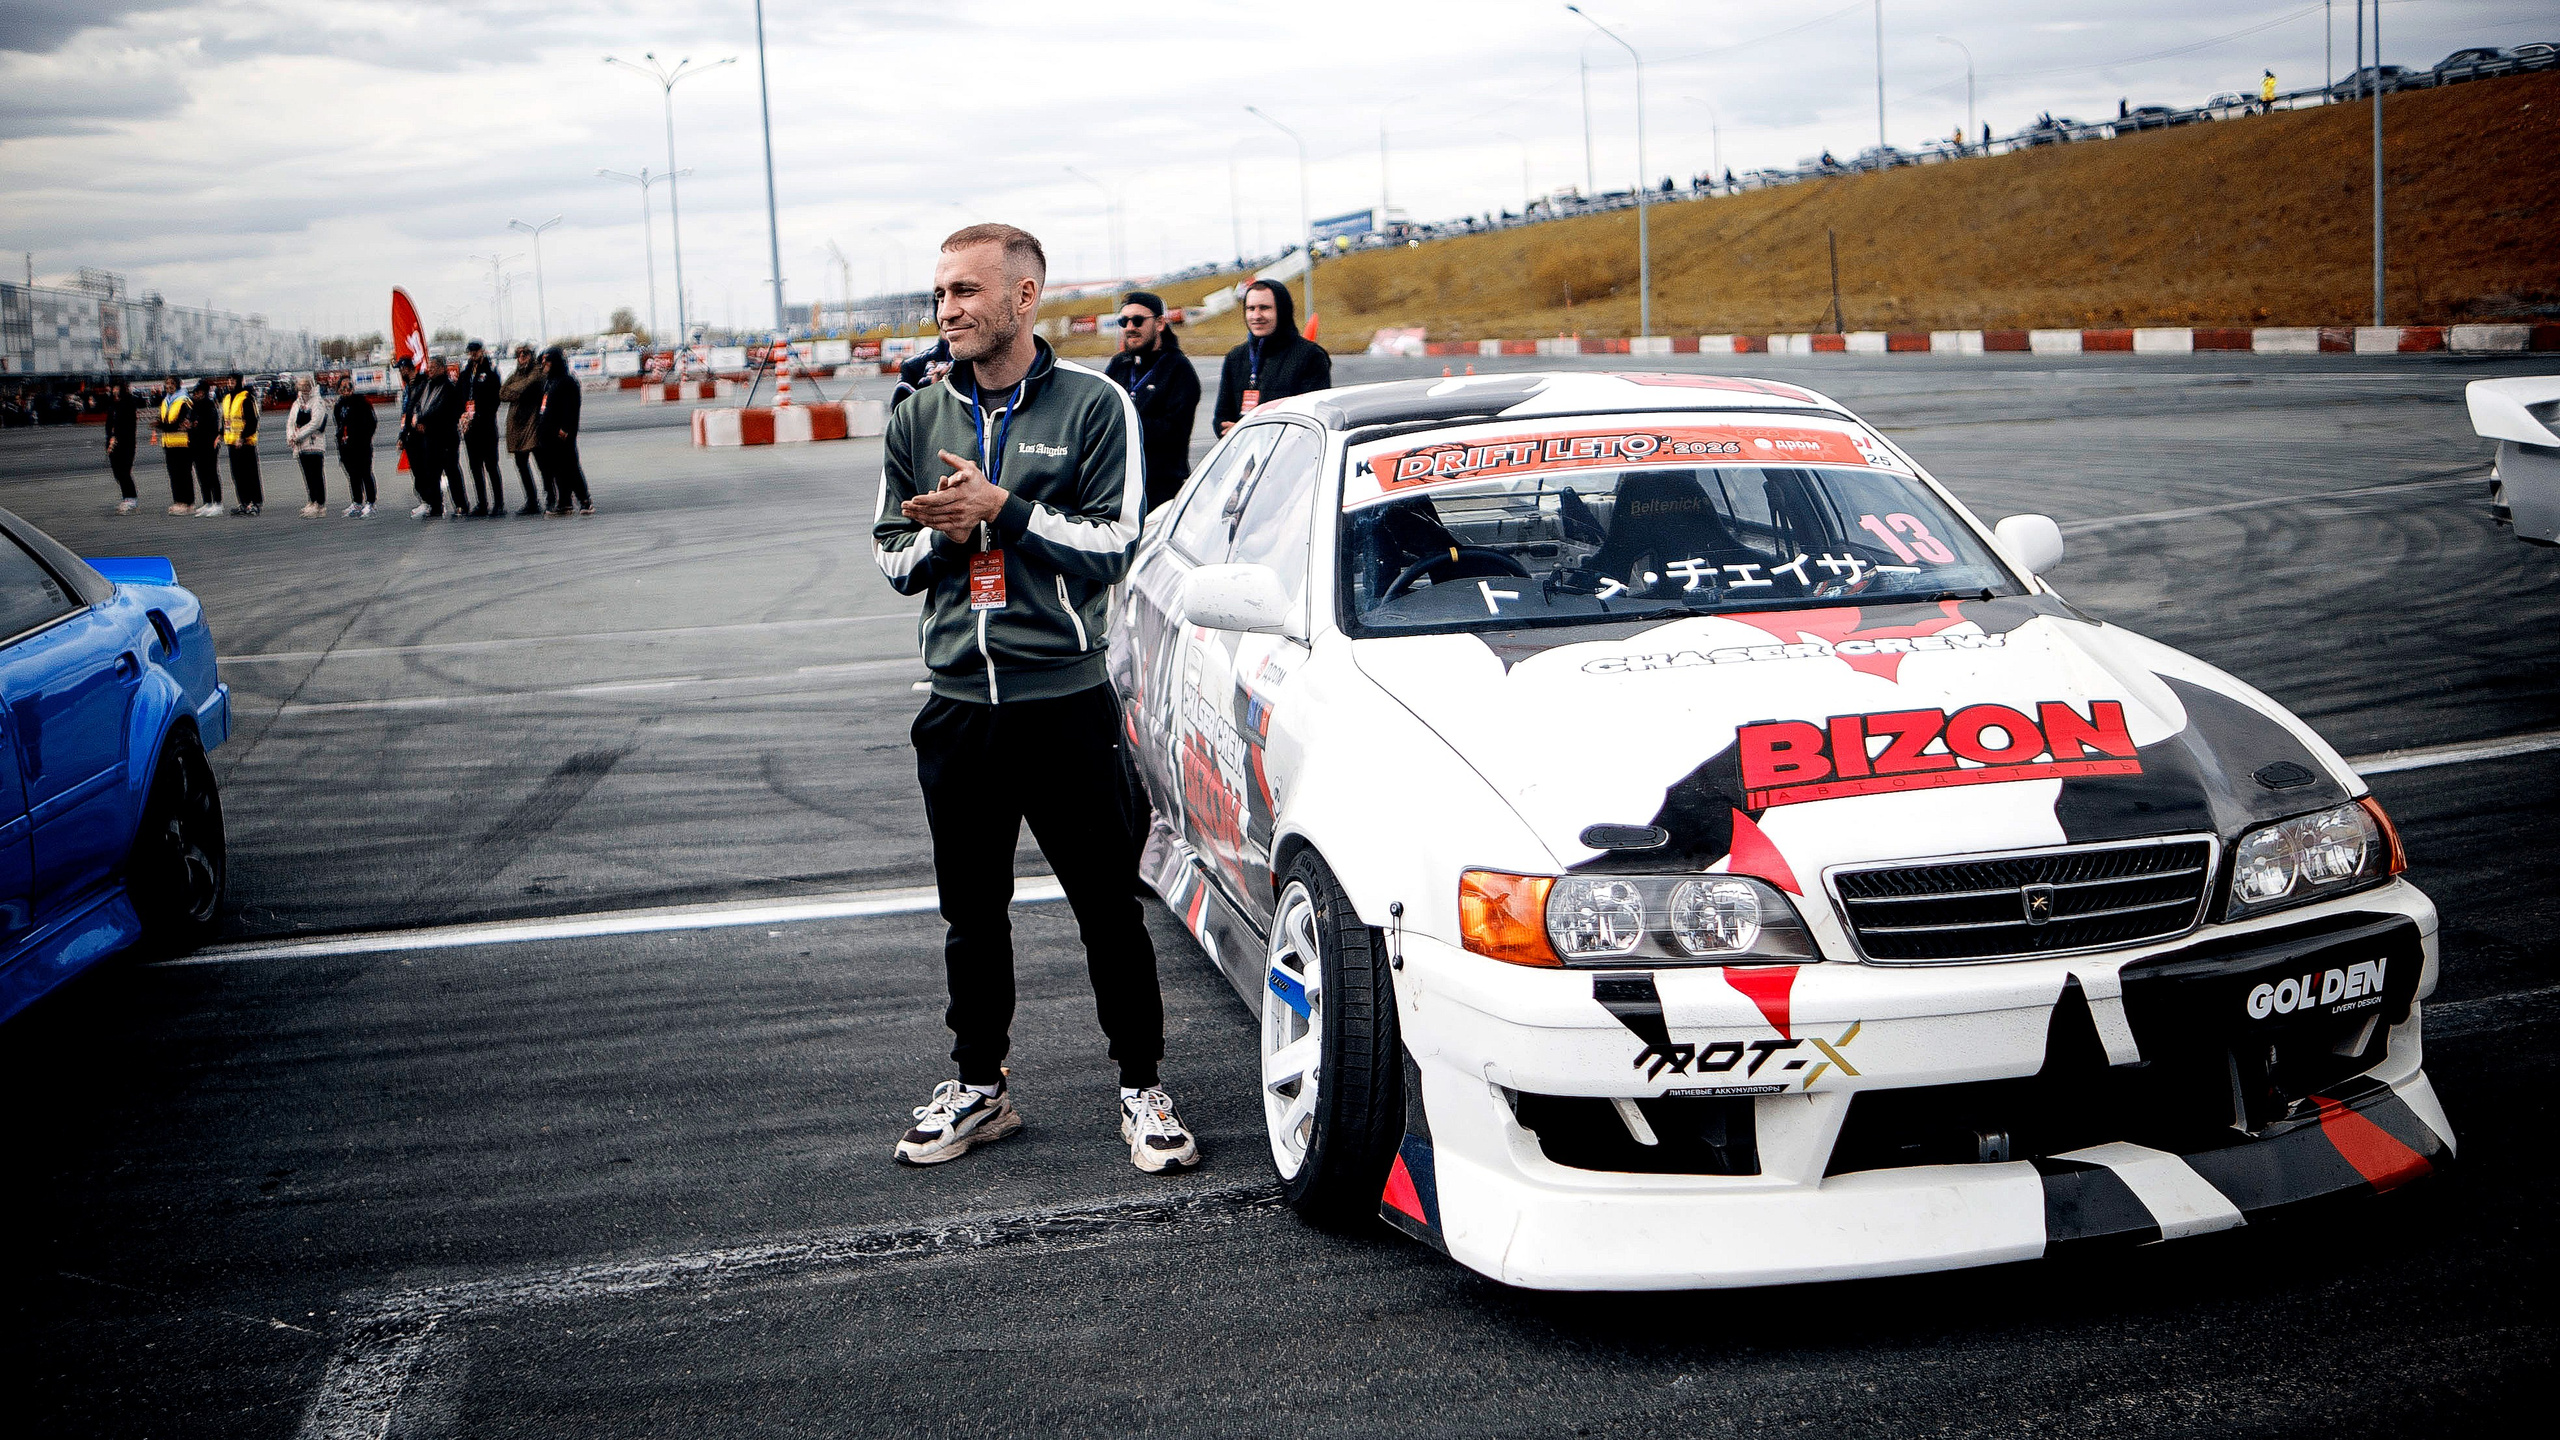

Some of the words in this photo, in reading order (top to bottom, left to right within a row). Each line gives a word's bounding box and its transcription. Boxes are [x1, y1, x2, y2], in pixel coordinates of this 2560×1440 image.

[1018, 442, 1036, 453] Los
[1036, 443, 1068, 458] Angeles
[1395, 440, 1540, 481] DRIFT
[1542, 433, 1660, 462] LETO
[1673, 441, 1741, 455] 2026
[1858, 512, 1955, 564] 13
[1581, 641, 1836, 675] CHASER
[1834, 632, 2007, 656] CREW
[1736, 699, 2139, 790] BIZON
[1776, 762, 2134, 801] АВТОДЕТАЛЬ
[2331, 1001, 2357, 1014] LIVERY
[2357, 995, 2383, 1008] DESIGN
[1668, 1088, 1713, 1097] ЛИТИЕВЫЕ
[1714, 1085, 1781, 1095] АККУМУЛЯТОРЫ
